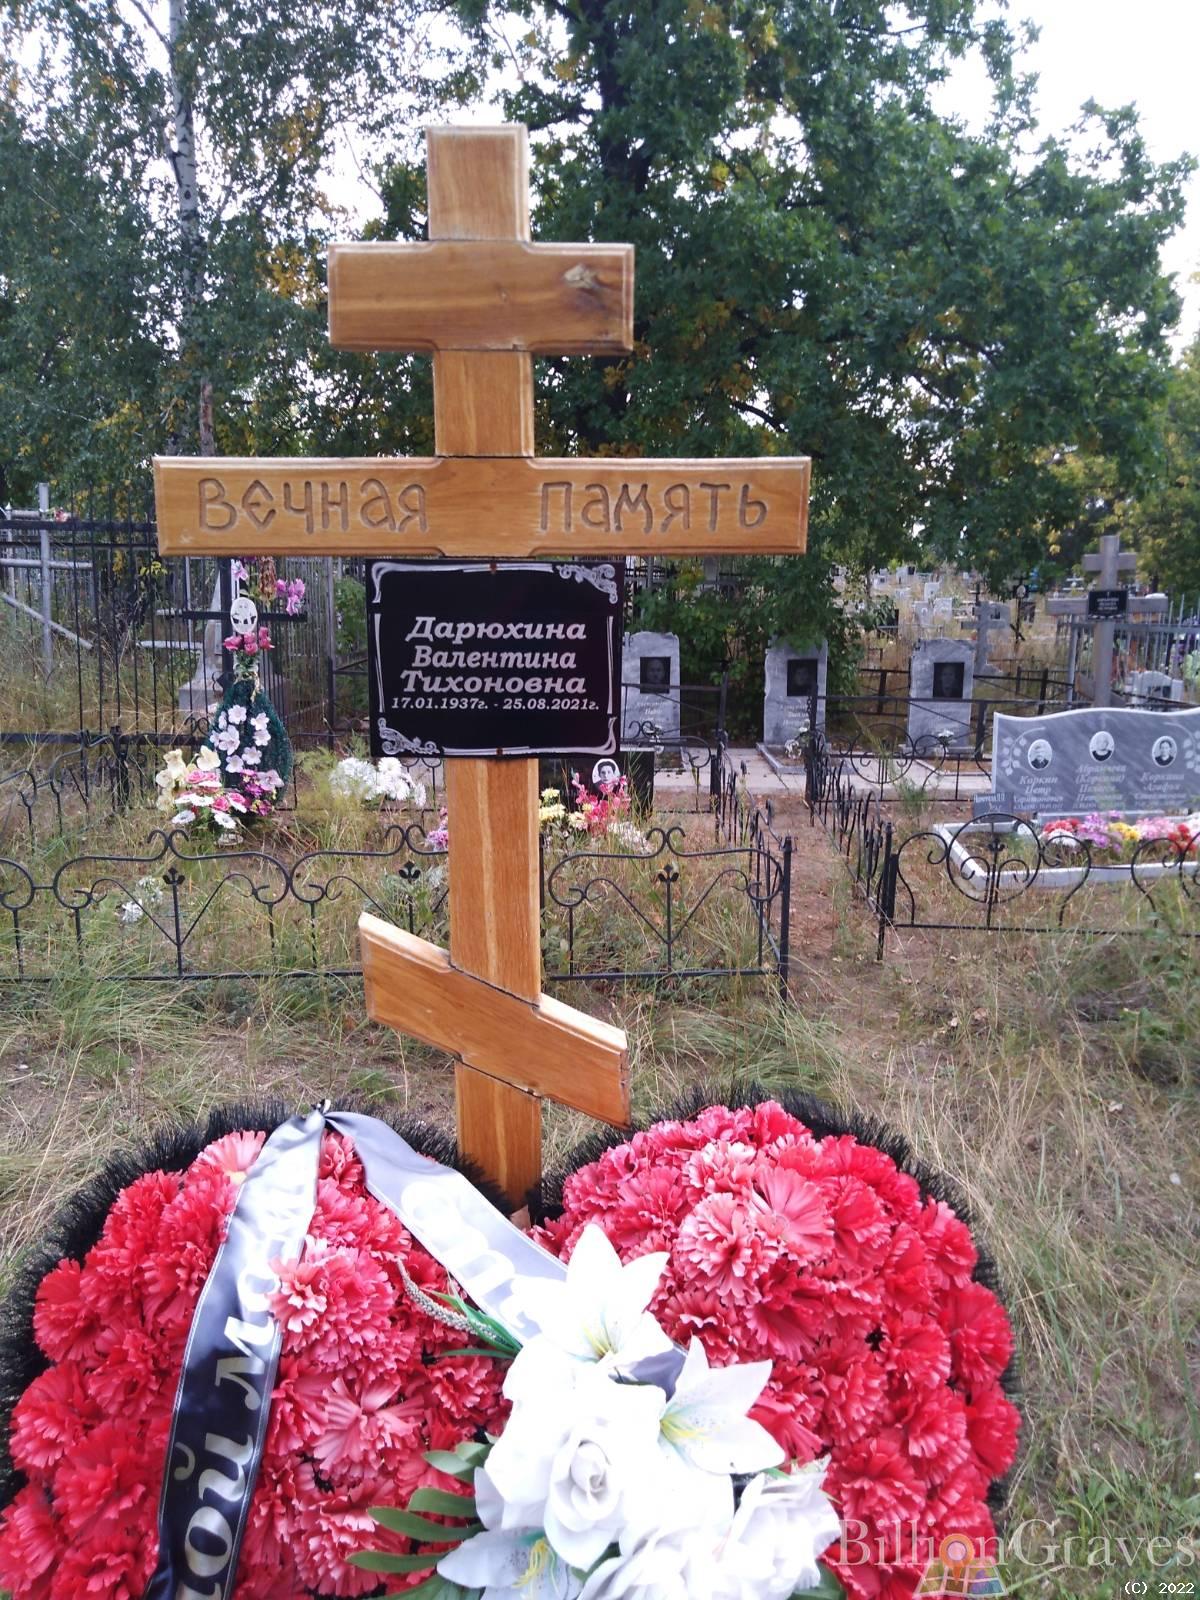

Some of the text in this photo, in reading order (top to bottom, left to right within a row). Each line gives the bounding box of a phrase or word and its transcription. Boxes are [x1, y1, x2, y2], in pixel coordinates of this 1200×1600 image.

[405, 616, 587, 645] Дарюхина
[411, 645, 577, 669] Валентина
[400, 670, 586, 694] Тихоновна
[391, 697, 488, 711] 17.01.1937г.
[502, 697, 600, 711] 25.08.2021г.
